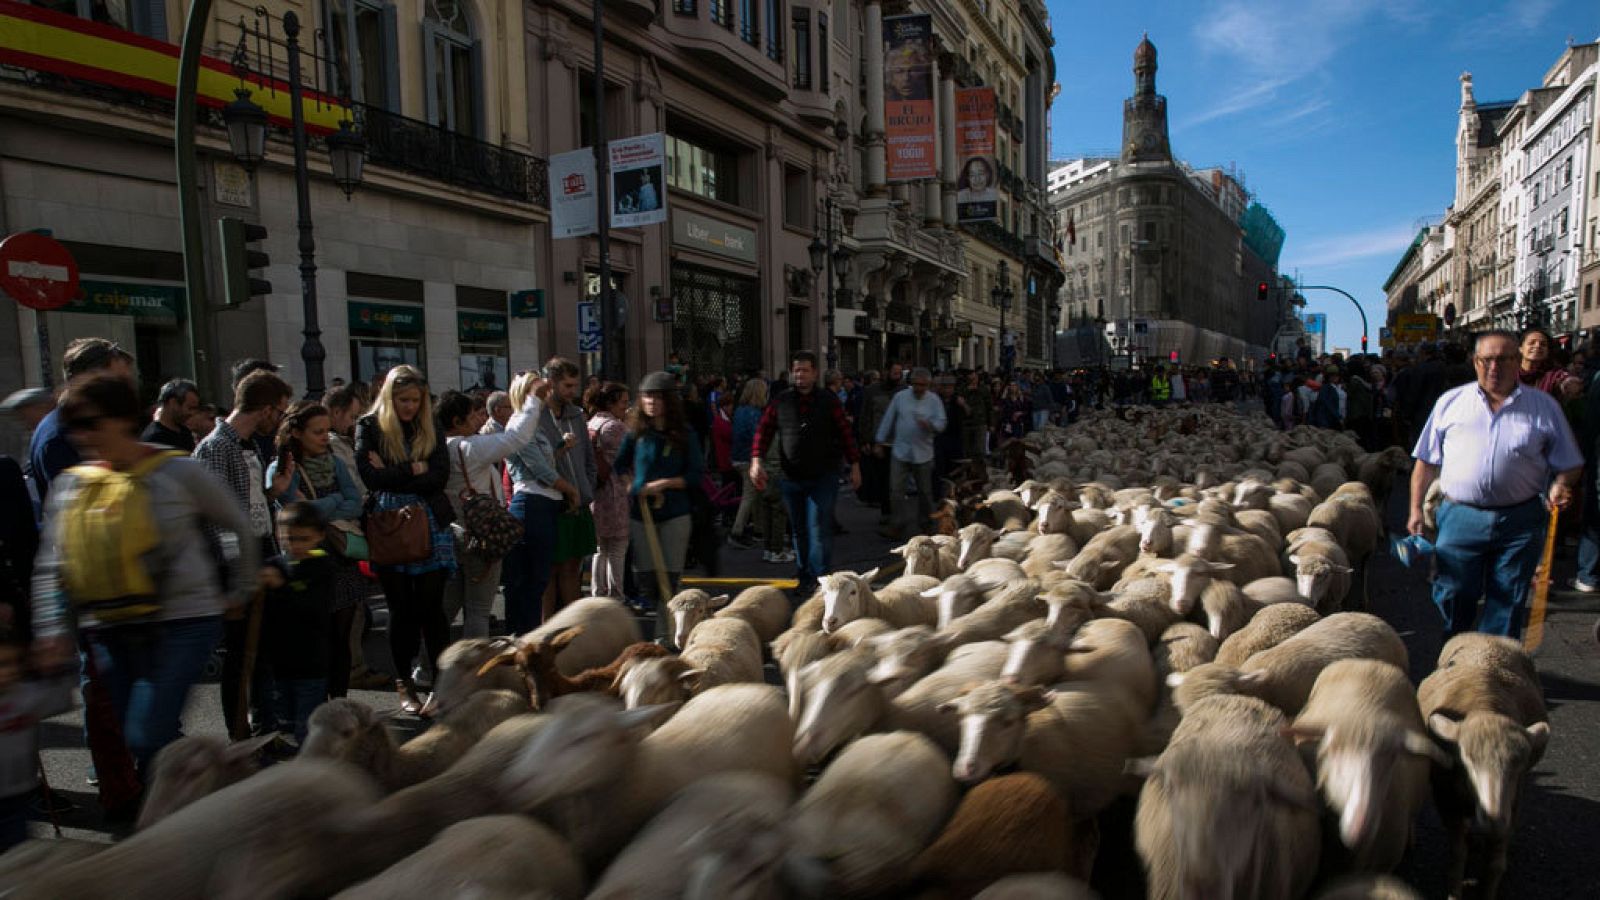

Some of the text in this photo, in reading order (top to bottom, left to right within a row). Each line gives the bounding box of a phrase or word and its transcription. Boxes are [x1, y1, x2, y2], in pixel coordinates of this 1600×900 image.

[902, 104, 914, 114] EL
[888, 114, 931, 126] BRUJO
[93, 288, 164, 309] cajamar
[373, 311, 414, 326] cajamar
[472, 319, 504, 333] cajamar
